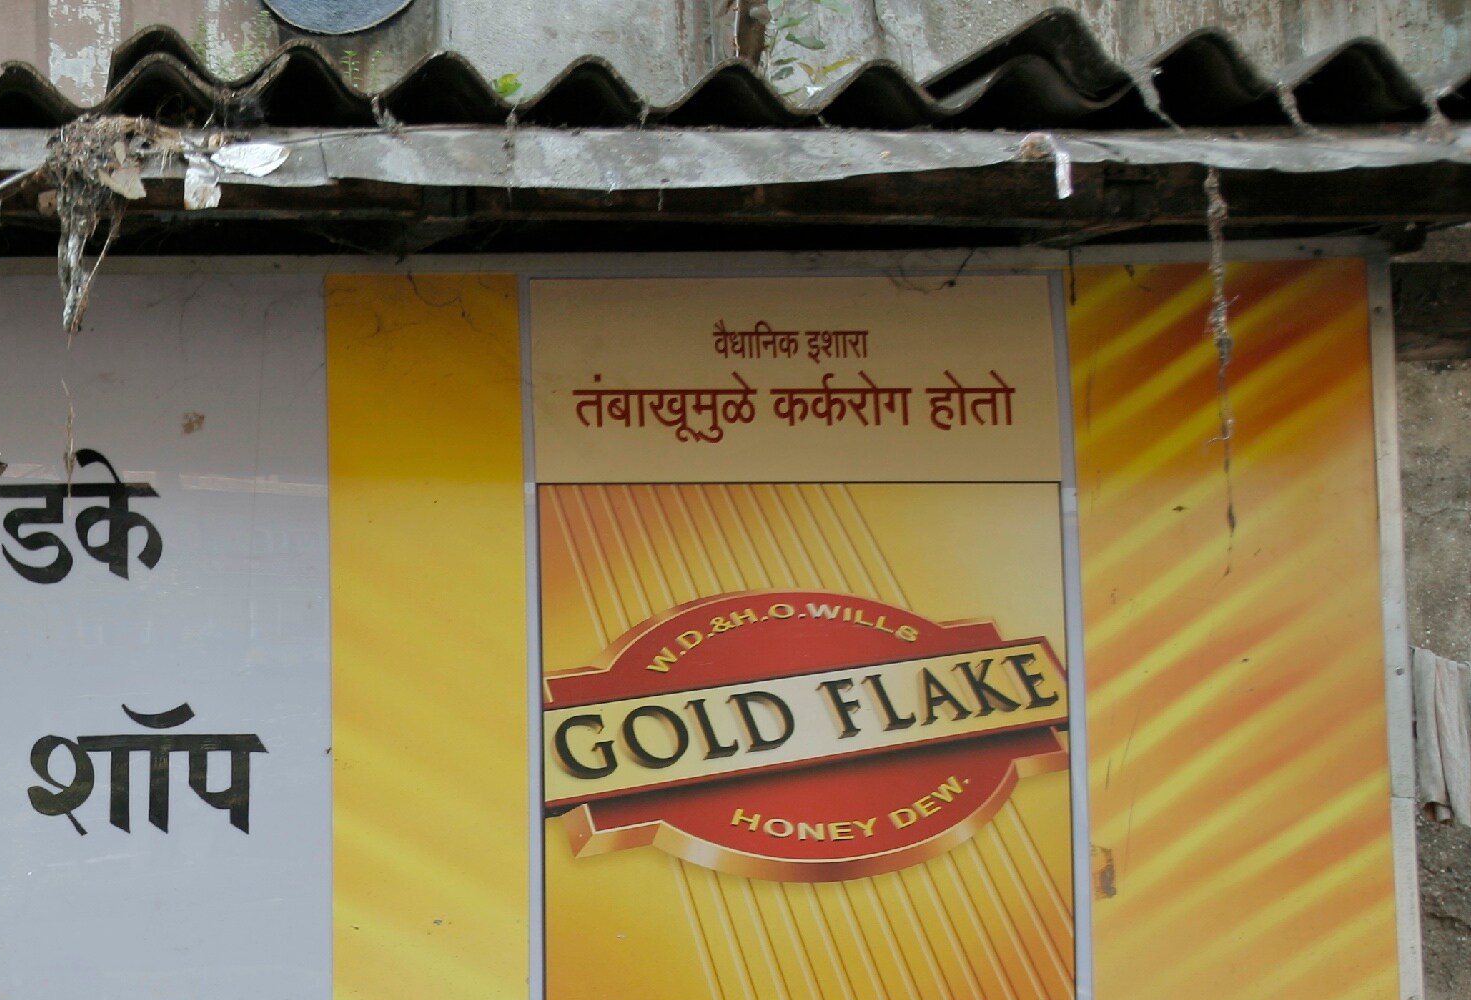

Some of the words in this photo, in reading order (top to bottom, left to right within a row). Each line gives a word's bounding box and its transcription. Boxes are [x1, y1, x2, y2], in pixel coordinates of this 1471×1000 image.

[713, 320, 799, 358] वैधानिक
[806, 330, 868, 363] इशारा
[573, 373, 757, 443] तंबाखूमुळे
[771, 372, 911, 429] कर्करोग
[926, 370, 1015, 431] होतो
[554, 689, 796, 780] GOLD
[815, 652, 1060, 740] FLAKE
[27, 703, 268, 836] शॉप
[730, 808, 876, 842] HONEY
